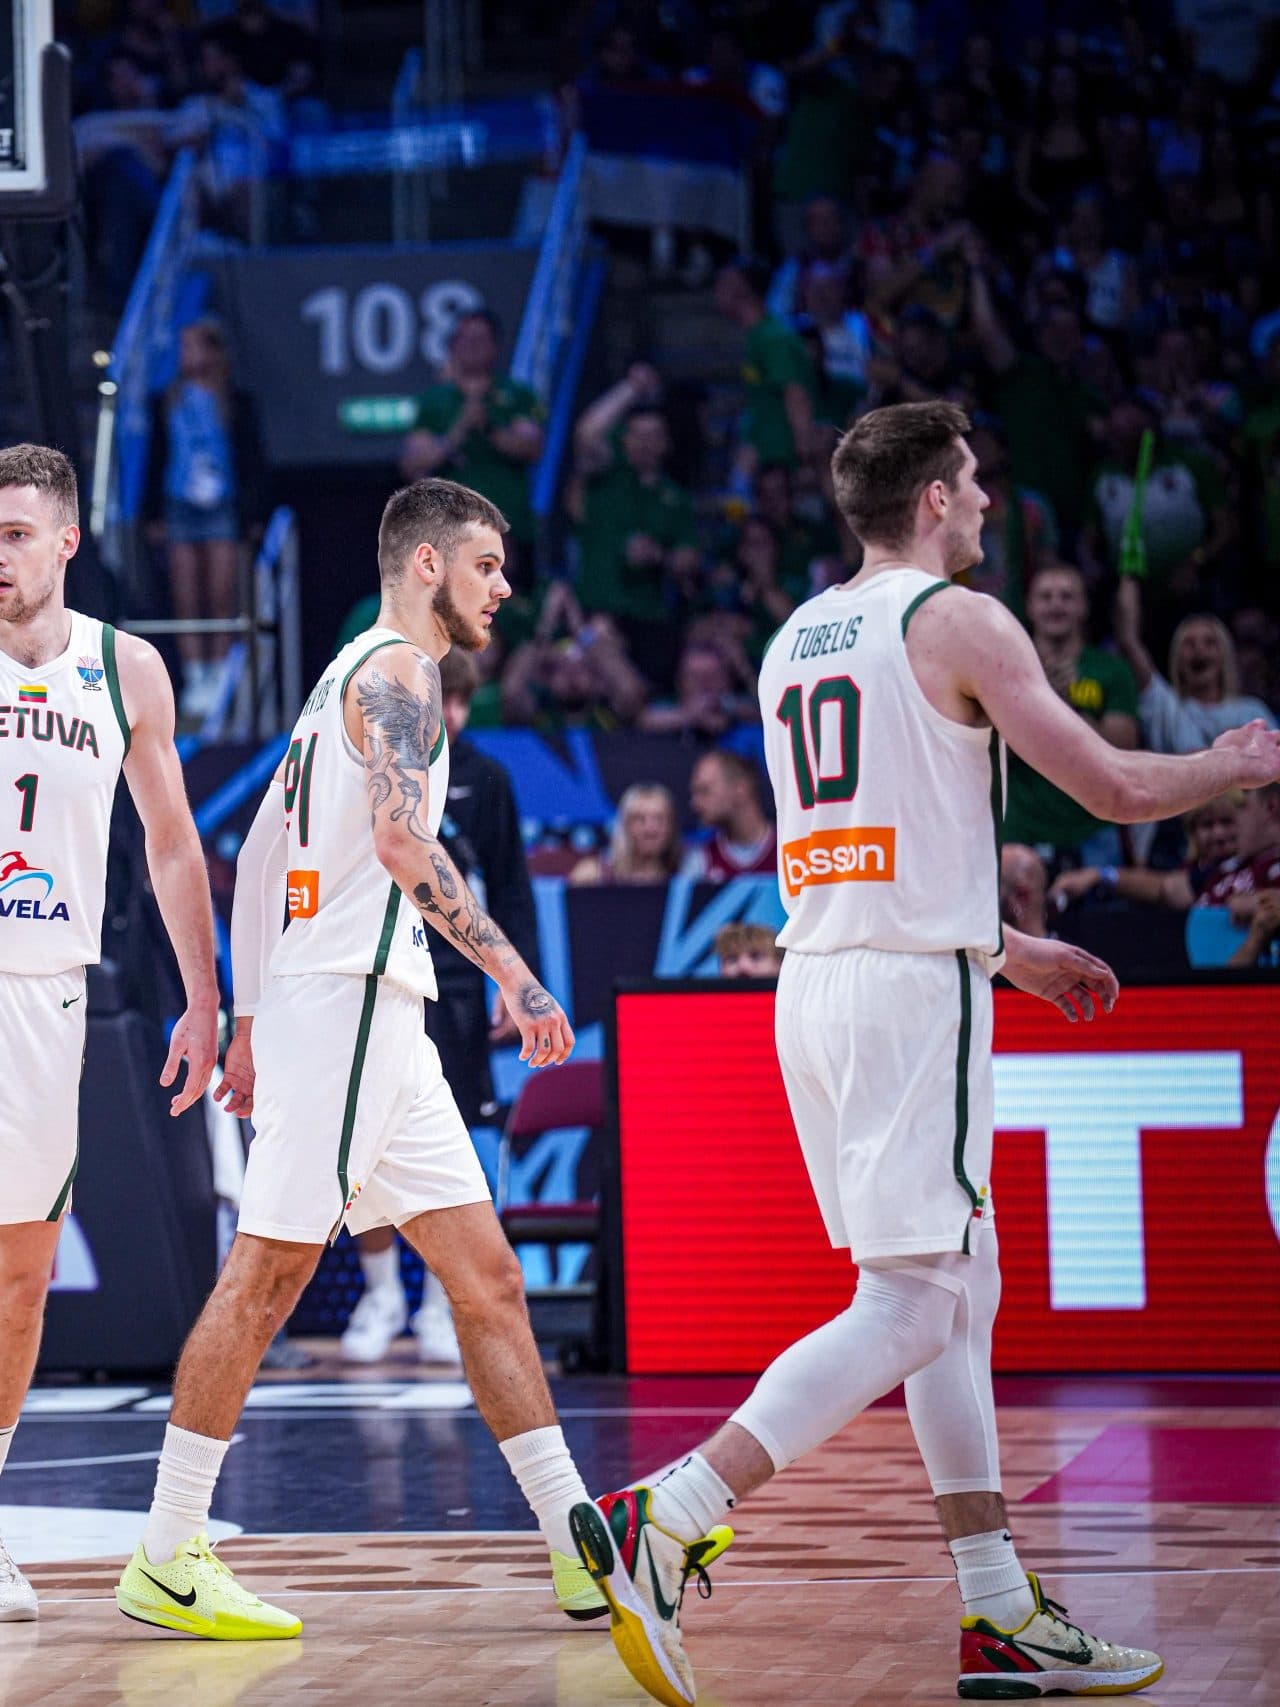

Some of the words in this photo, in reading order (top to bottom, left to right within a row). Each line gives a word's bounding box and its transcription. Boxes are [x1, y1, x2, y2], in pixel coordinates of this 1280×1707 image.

[789, 615, 864, 662] TUBELIS
[776, 675, 861, 810] 10
[14, 773, 39, 832] 1
